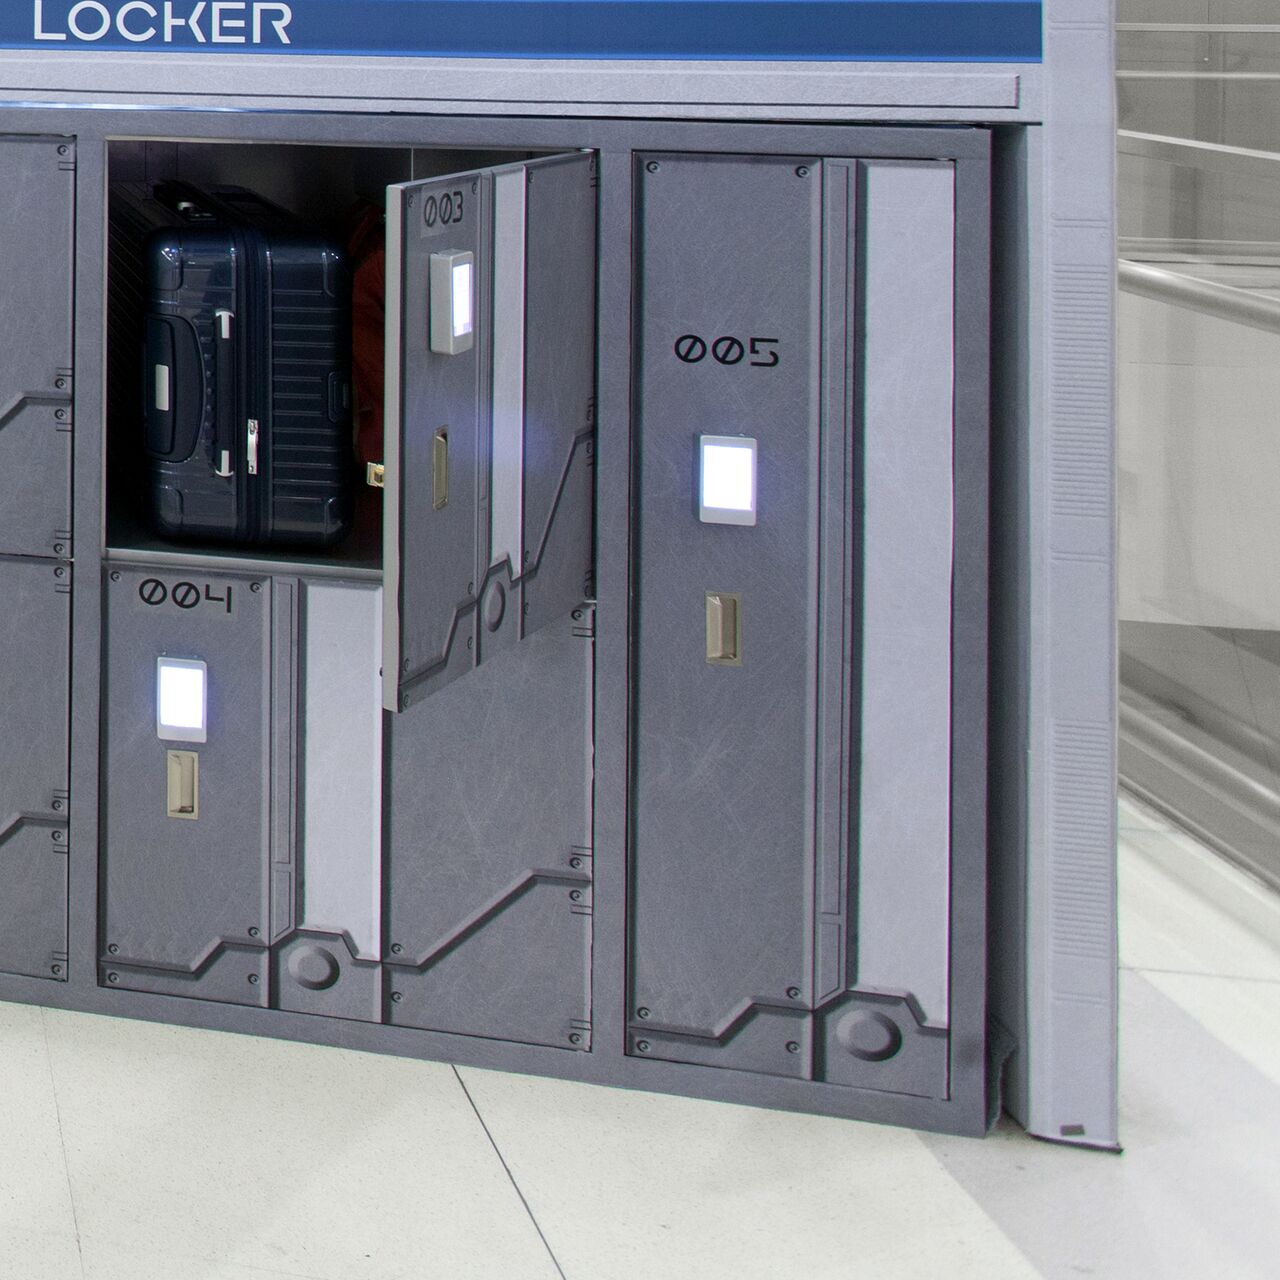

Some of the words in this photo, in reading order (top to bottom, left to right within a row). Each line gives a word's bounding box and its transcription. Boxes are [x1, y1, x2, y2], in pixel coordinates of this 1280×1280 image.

[34, 0, 292, 44] LOCKER
[424, 191, 464, 227] 003
[674, 334, 779, 367] 005
[139, 578, 232, 613] 004
